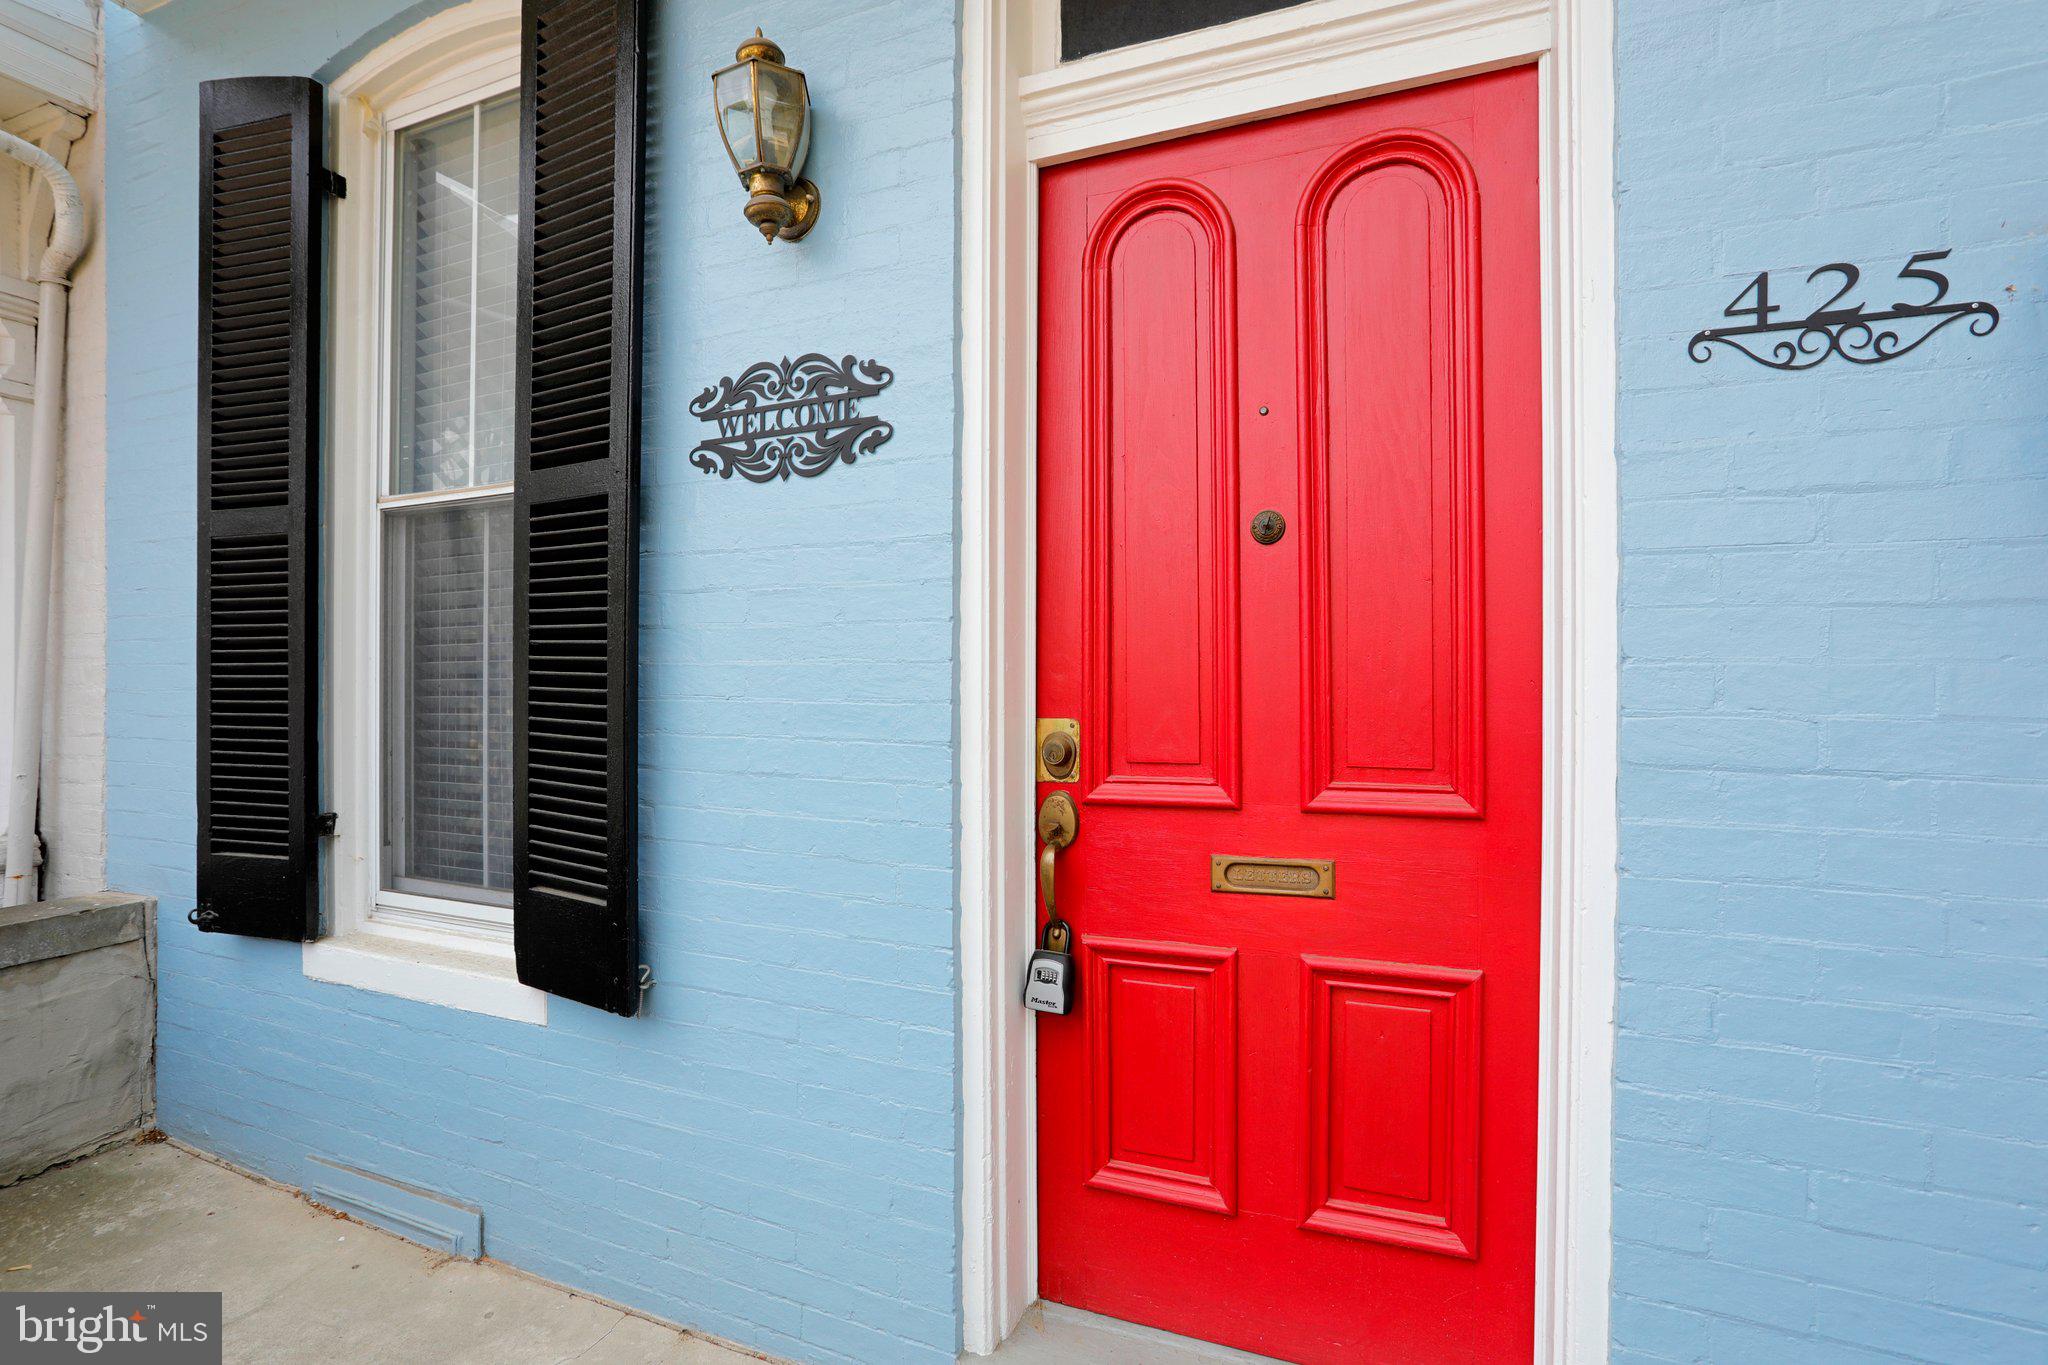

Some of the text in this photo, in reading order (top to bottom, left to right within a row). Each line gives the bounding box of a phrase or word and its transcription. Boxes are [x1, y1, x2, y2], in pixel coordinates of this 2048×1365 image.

[1723, 248, 1952, 330] 425
[716, 396, 860, 439] WELCOME
[1231, 867, 1312, 885] LETTERS
[1030, 996, 1057, 1007] Master
